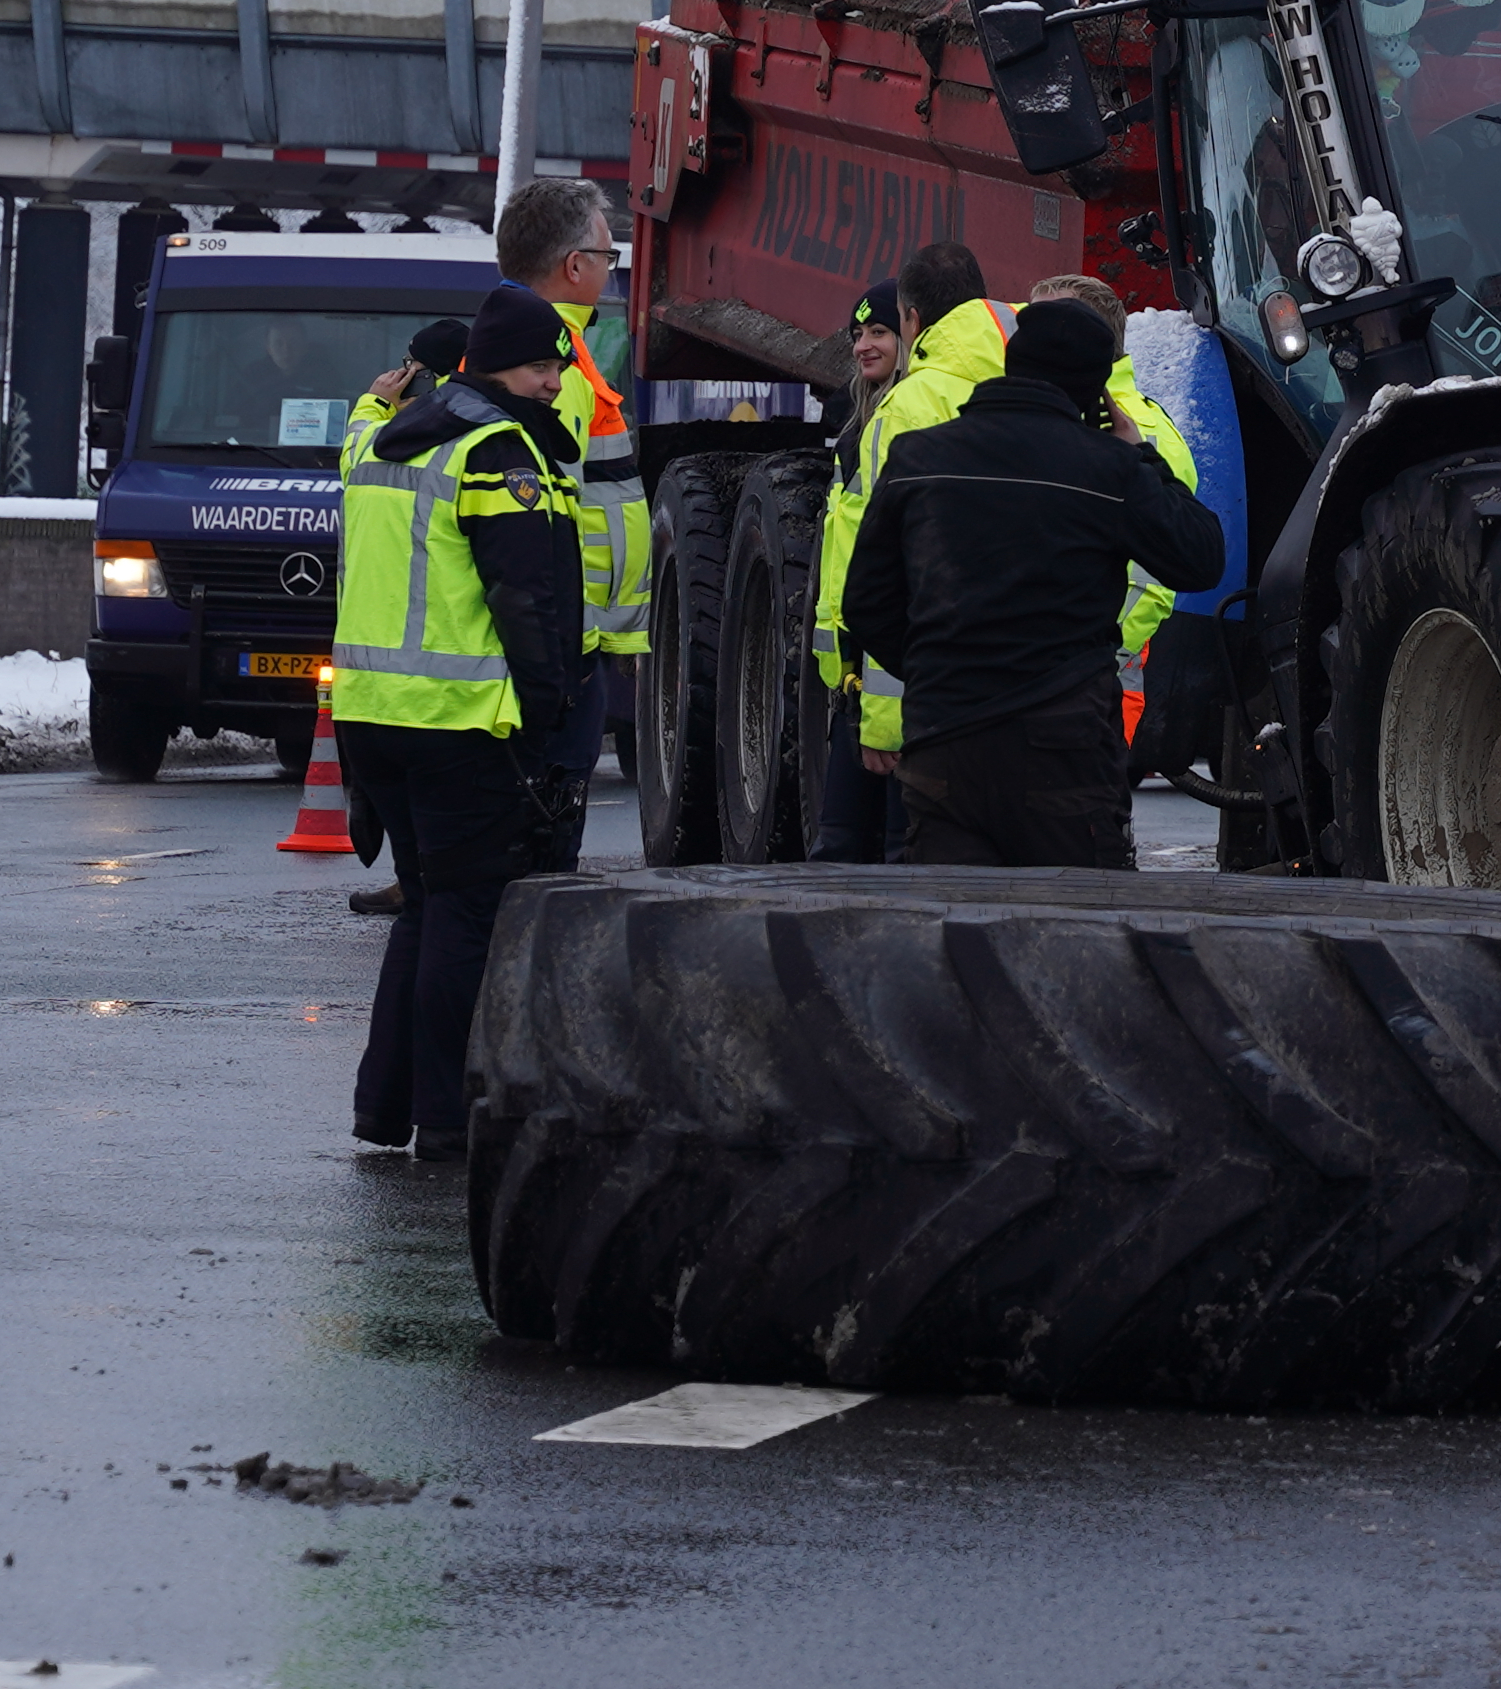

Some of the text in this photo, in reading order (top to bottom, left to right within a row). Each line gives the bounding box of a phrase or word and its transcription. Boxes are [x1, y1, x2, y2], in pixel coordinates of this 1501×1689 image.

[1290, 54, 1361, 252] HOLLA
[198, 238, 227, 251] 509
[191, 505, 340, 532] WAARDETRAN
